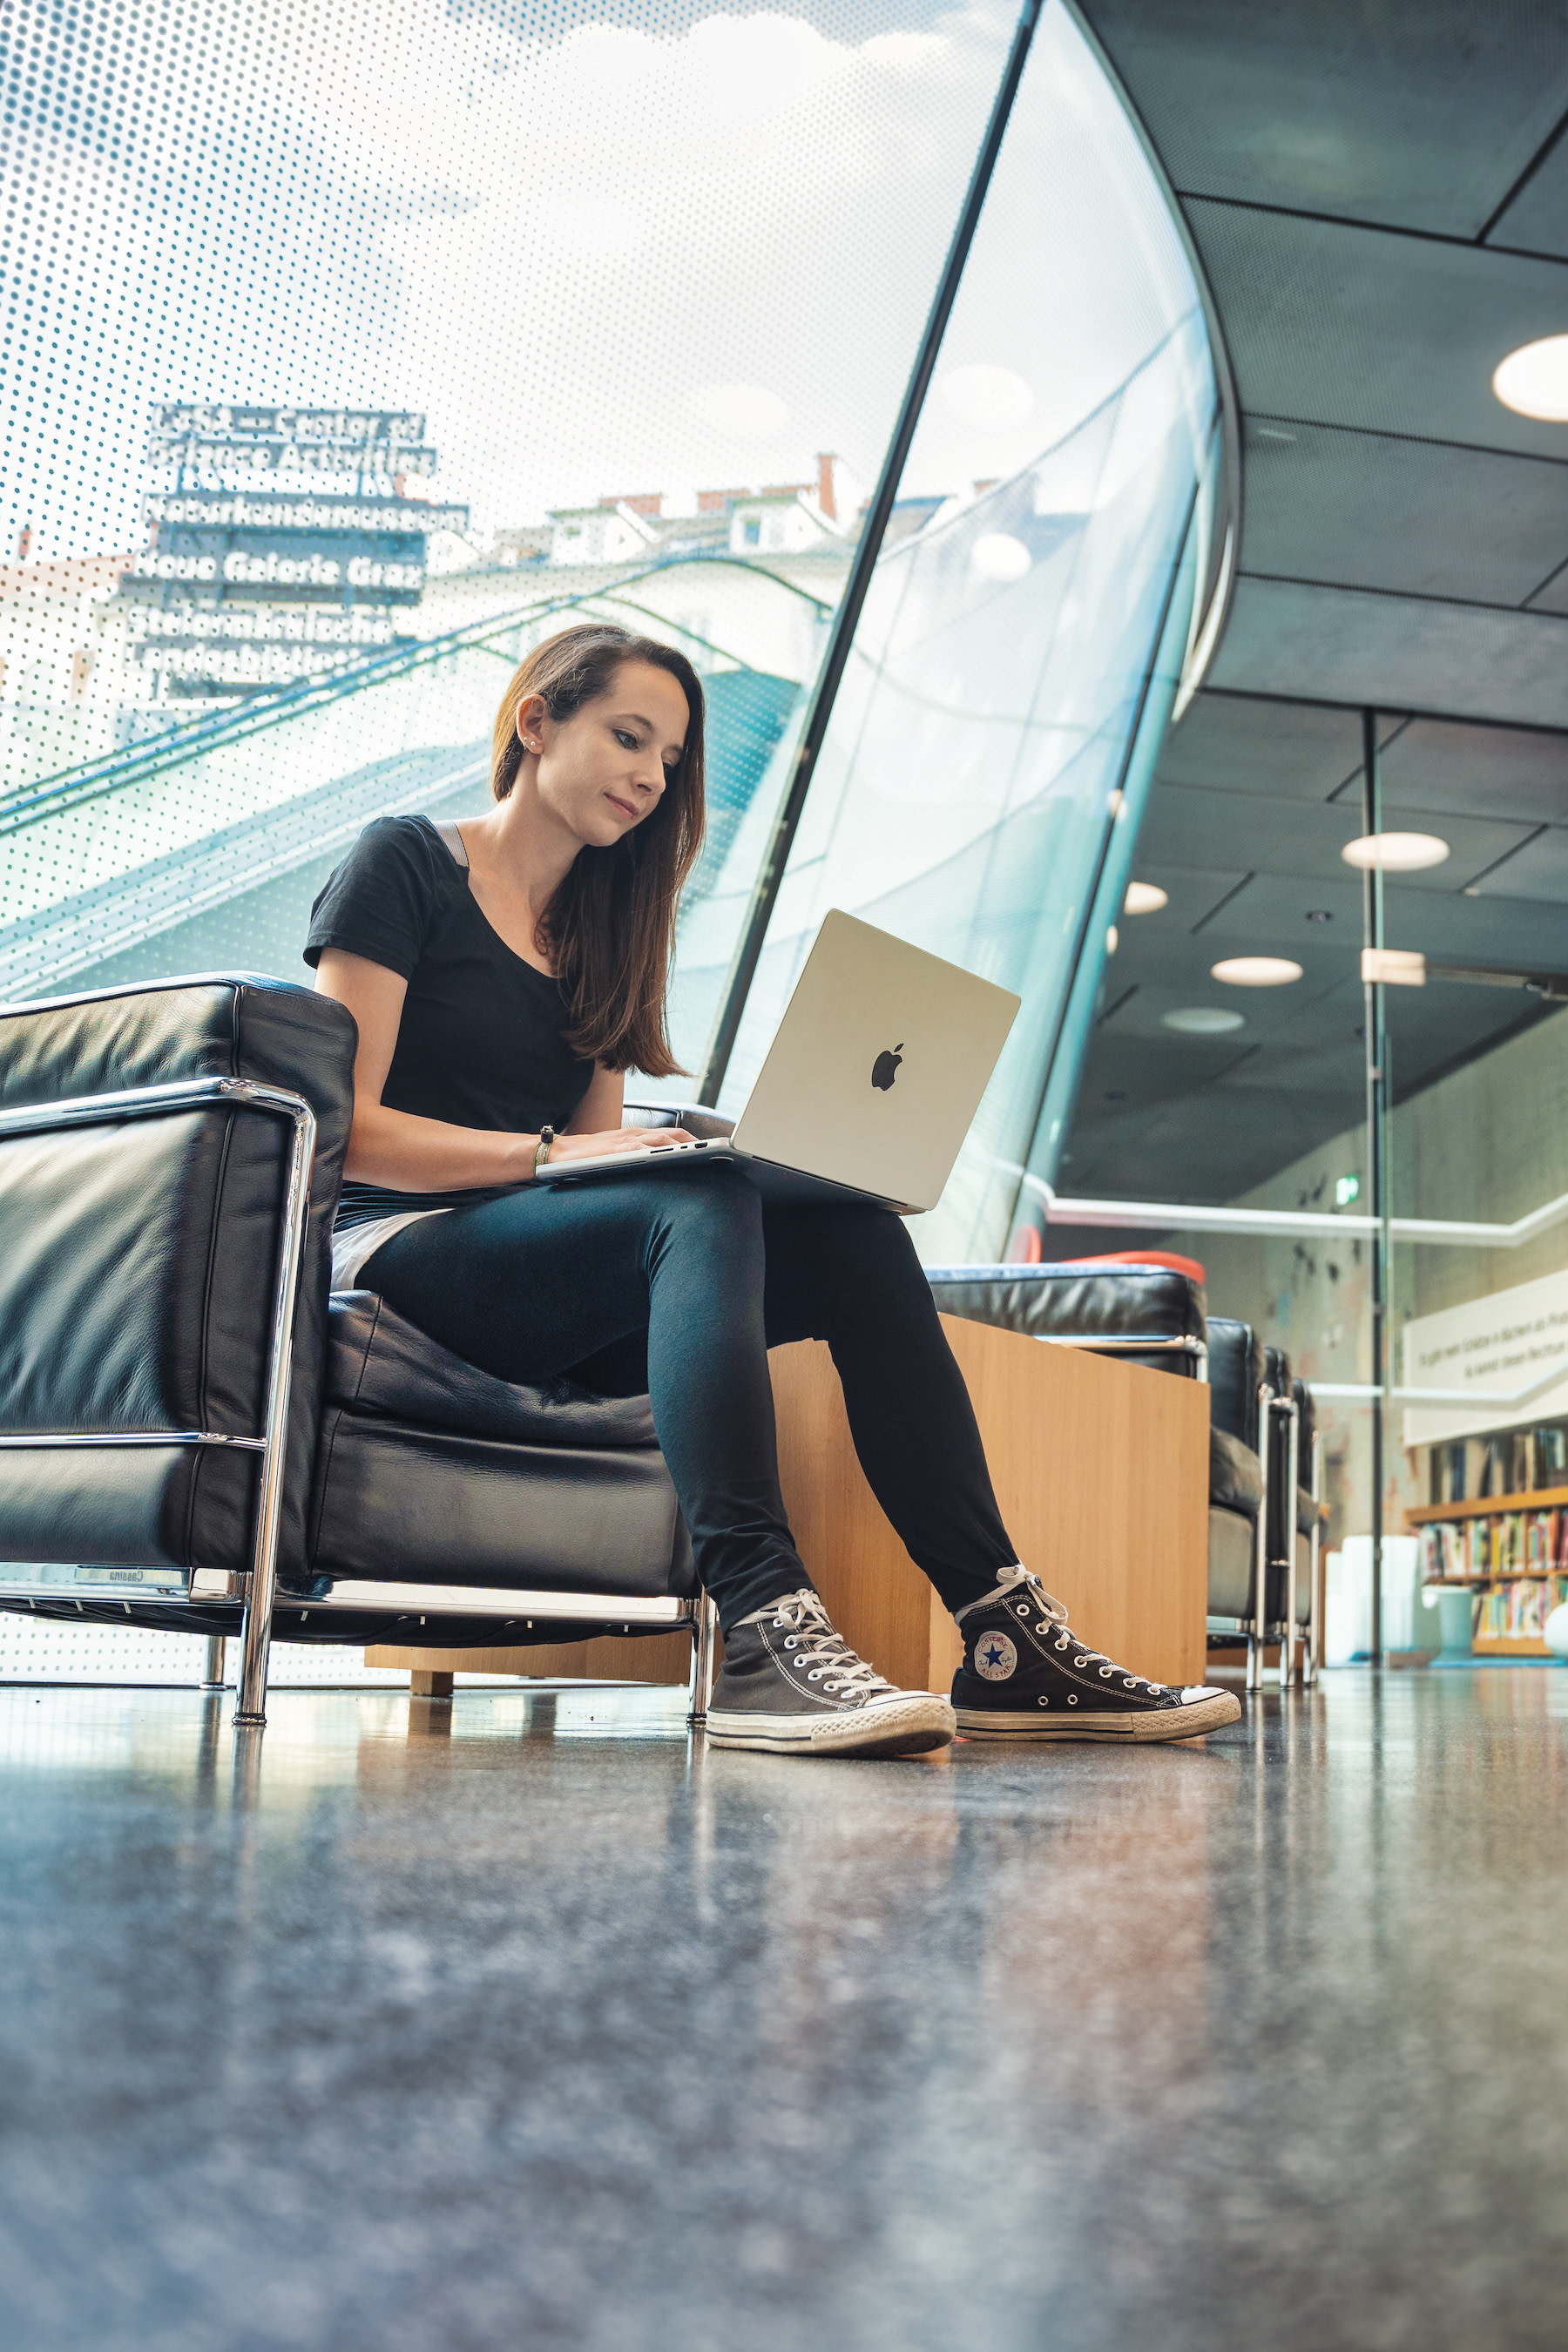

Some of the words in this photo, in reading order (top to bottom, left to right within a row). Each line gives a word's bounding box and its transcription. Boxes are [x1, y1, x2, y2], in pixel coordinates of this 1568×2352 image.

[153, 405, 234, 433] CoSA
[275, 408, 382, 437] Center
[387, 413, 423, 438] of
[149, 437, 272, 469] Science
[276, 443, 436, 476] Activities
[142, 493, 469, 532] Naturkundemuseum
[132, 549, 217, 581] Neue
[222, 551, 341, 585] Galerie
[347, 555, 423, 590] Graz
[127, 605, 392, 645] Steiermärkische
[981, 1667, 994, 1678] ALL
[995, 1665, 1011, 1679] STAR
